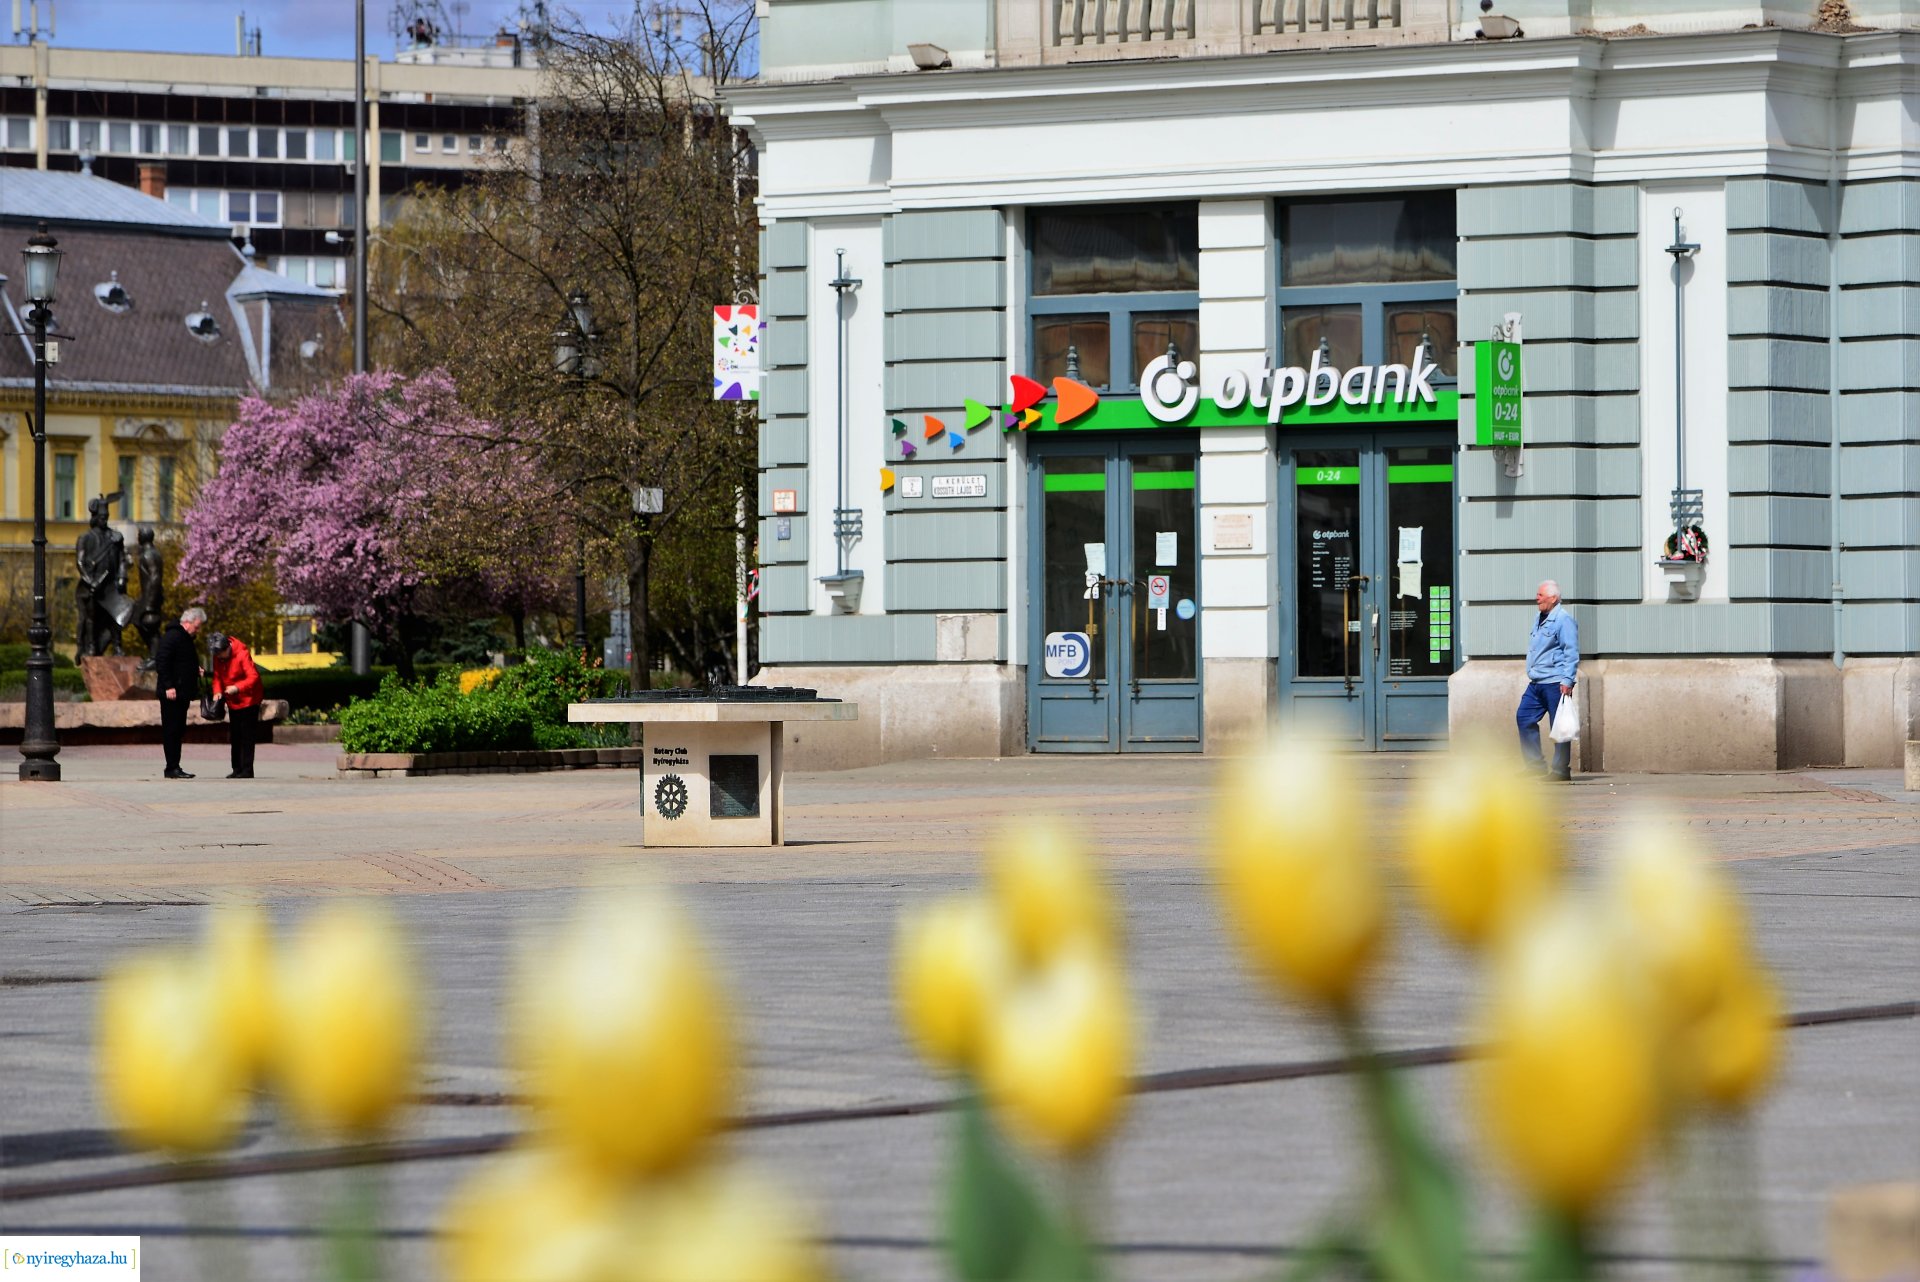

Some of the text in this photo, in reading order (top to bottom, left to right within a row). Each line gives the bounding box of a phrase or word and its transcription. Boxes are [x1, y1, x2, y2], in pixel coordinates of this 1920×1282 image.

[1213, 345, 1438, 424] otpbank
[1493, 384, 1520, 398] otpbank
[1494, 402, 1519, 421] 0-24
[1316, 470, 1341, 481] 0-24
[1321, 530, 1350, 540] otpbank
[1046, 644, 1077, 658] MFB
[653, 747, 688, 757] Rotary Club
